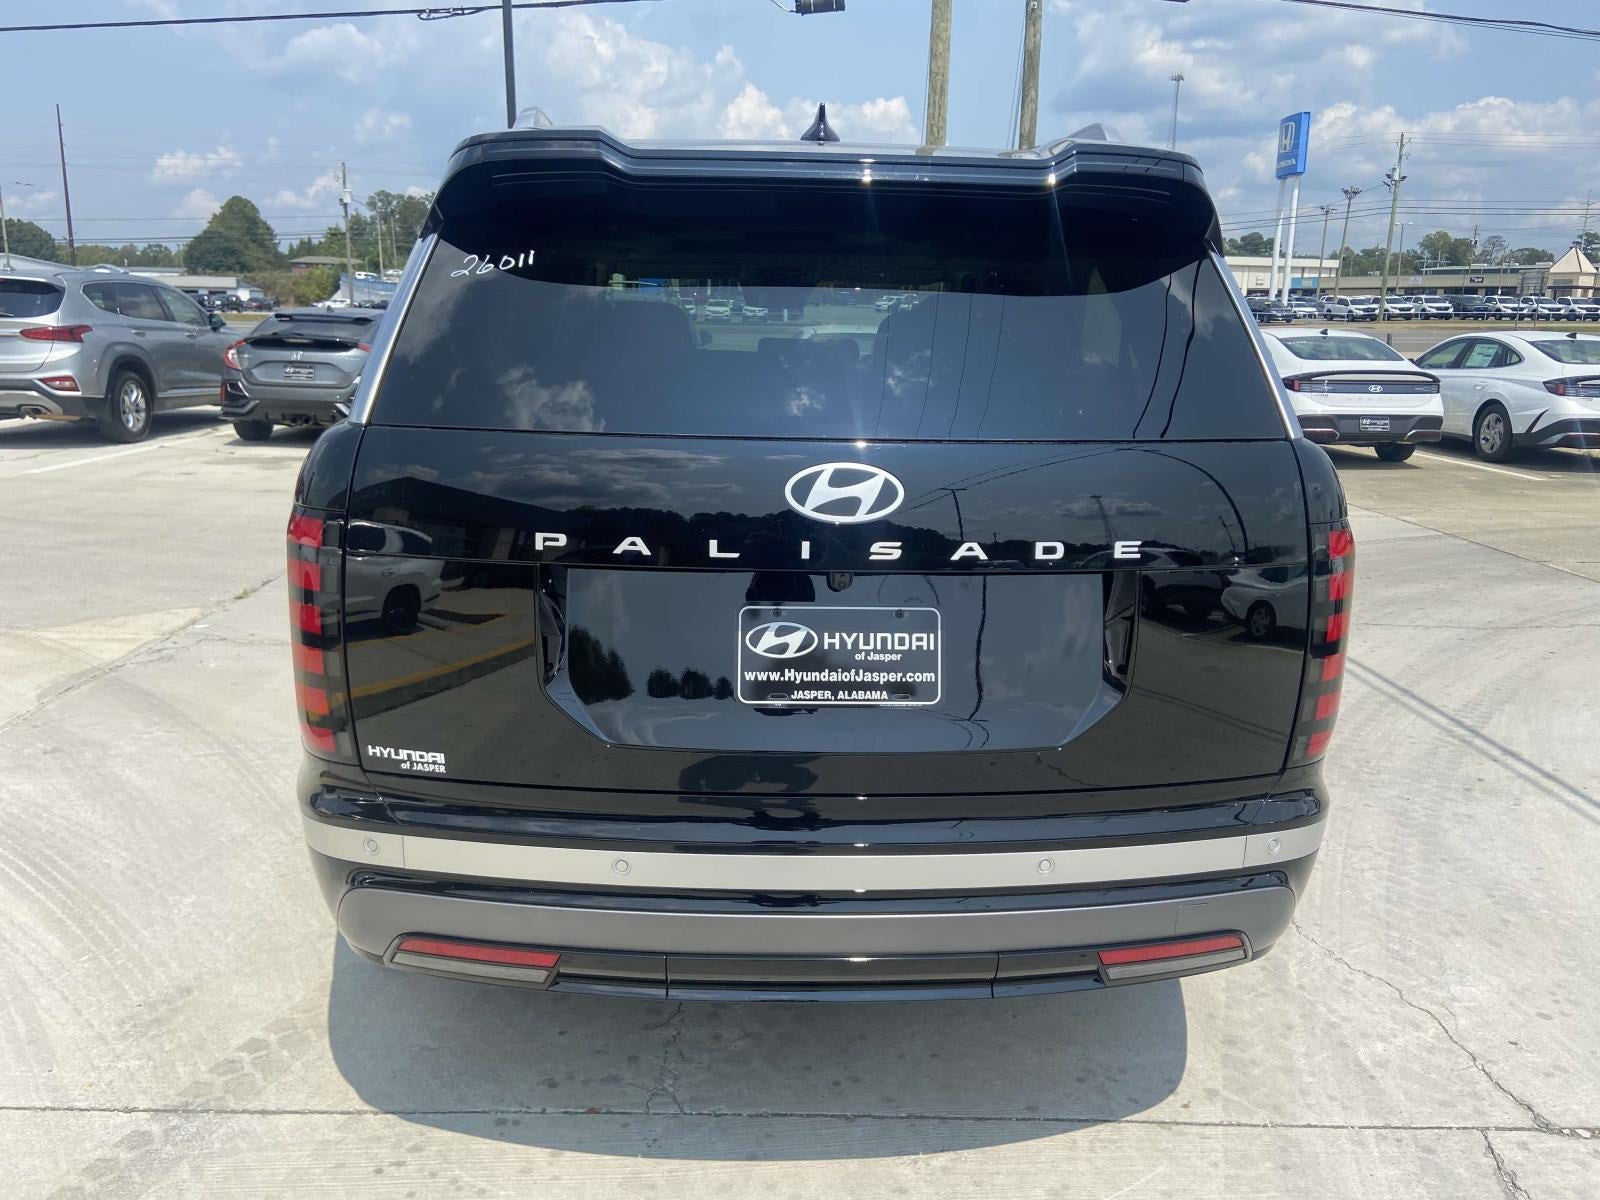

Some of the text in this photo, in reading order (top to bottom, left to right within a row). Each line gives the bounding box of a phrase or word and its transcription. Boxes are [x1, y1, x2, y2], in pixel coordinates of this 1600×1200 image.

[450, 250, 535, 277] 26011
[534, 532, 1142, 561] PALISADE
[823, 632, 935, 651] HYUNDAI
[855, 651, 902, 663] of Jasper
[744, 668, 935, 684] www.HyundaiofJasper.com
[791, 690, 889, 701] JASPER, ALABAMA
[367, 745, 445, 764] HYUNDAI
[401, 761, 446, 773] of JASPER
